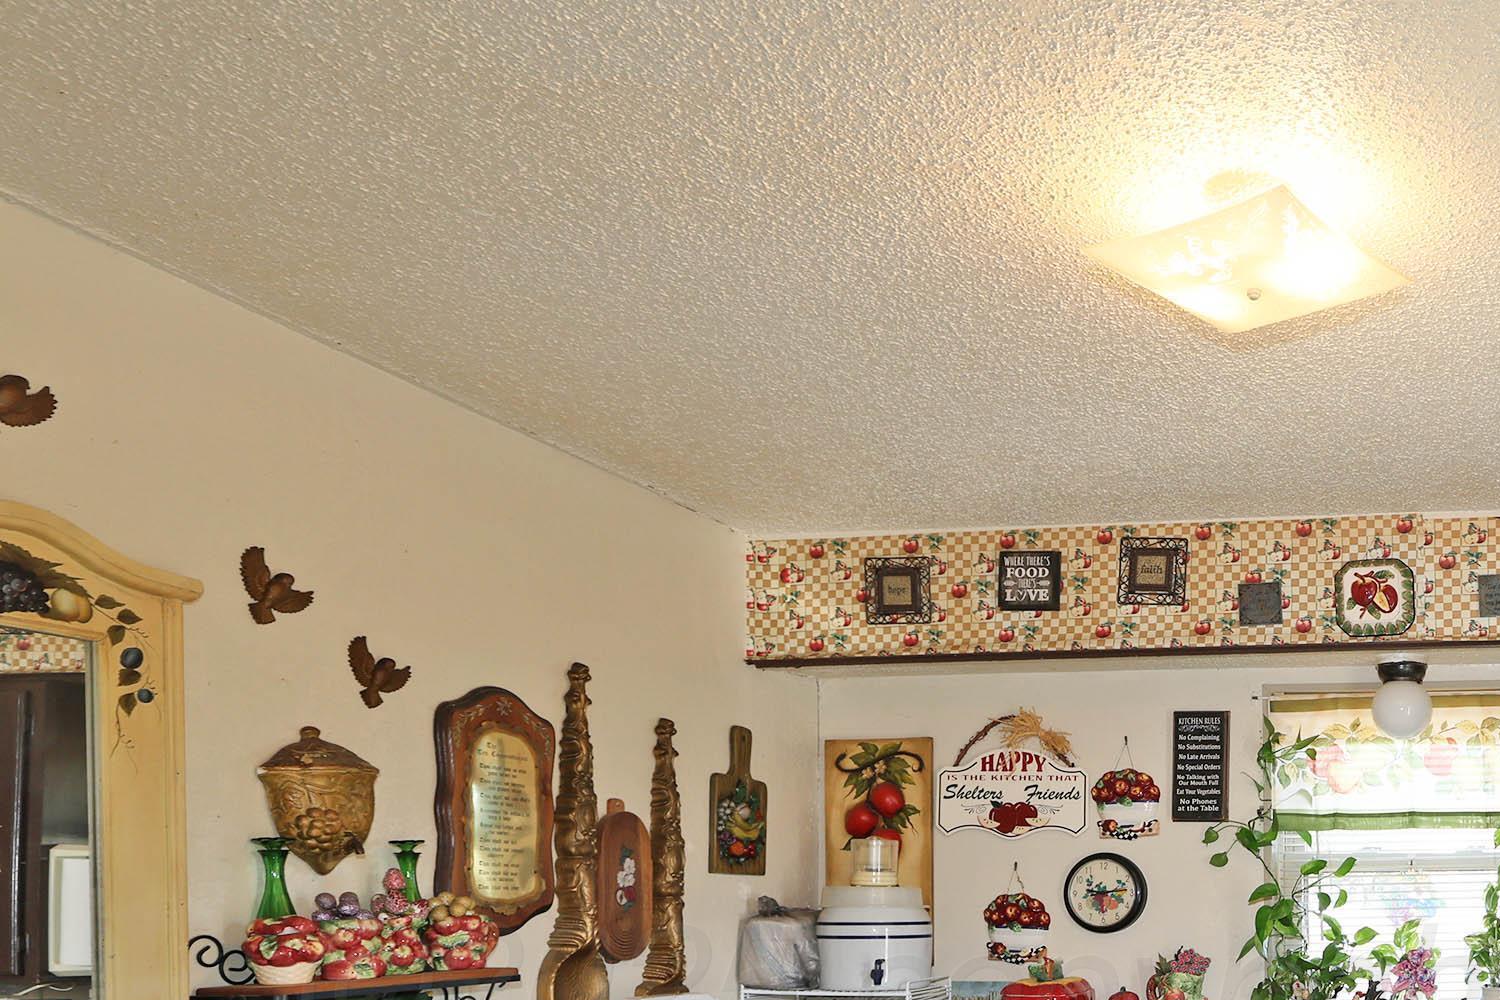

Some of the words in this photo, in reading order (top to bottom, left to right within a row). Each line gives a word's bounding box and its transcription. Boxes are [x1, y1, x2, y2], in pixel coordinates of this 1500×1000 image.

[1003, 556, 1025, 567] WHERE
[1026, 556, 1050, 567] THERE'S
[1140, 562, 1163, 574] faith
[1006, 567, 1050, 578] FOOD
[1178, 717, 1204, 725] KITCHEN
[1204, 717, 1221, 725] RULES
[1187, 734, 1220, 742] Complaining
[980, 751, 1047, 772] HAPPY
[943, 784, 1003, 800] Shelters
[1023, 784, 1082, 803] Friends
[1197, 788, 1221, 796] Vegetables
[1200, 804, 1220, 812] Table
[1085, 866, 1092, 874] 11
[1100, 861, 1109, 871] 12
[1125, 875, 1130, 883] 2
[1073, 889, 1078, 897] 9
[1130, 888, 1135, 897] 3
[1078, 902, 1083, 912] 8
[1089, 913, 1093, 921] 7
[1101, 916, 1106, 924] 6
[1115, 912, 1120, 921] 5
